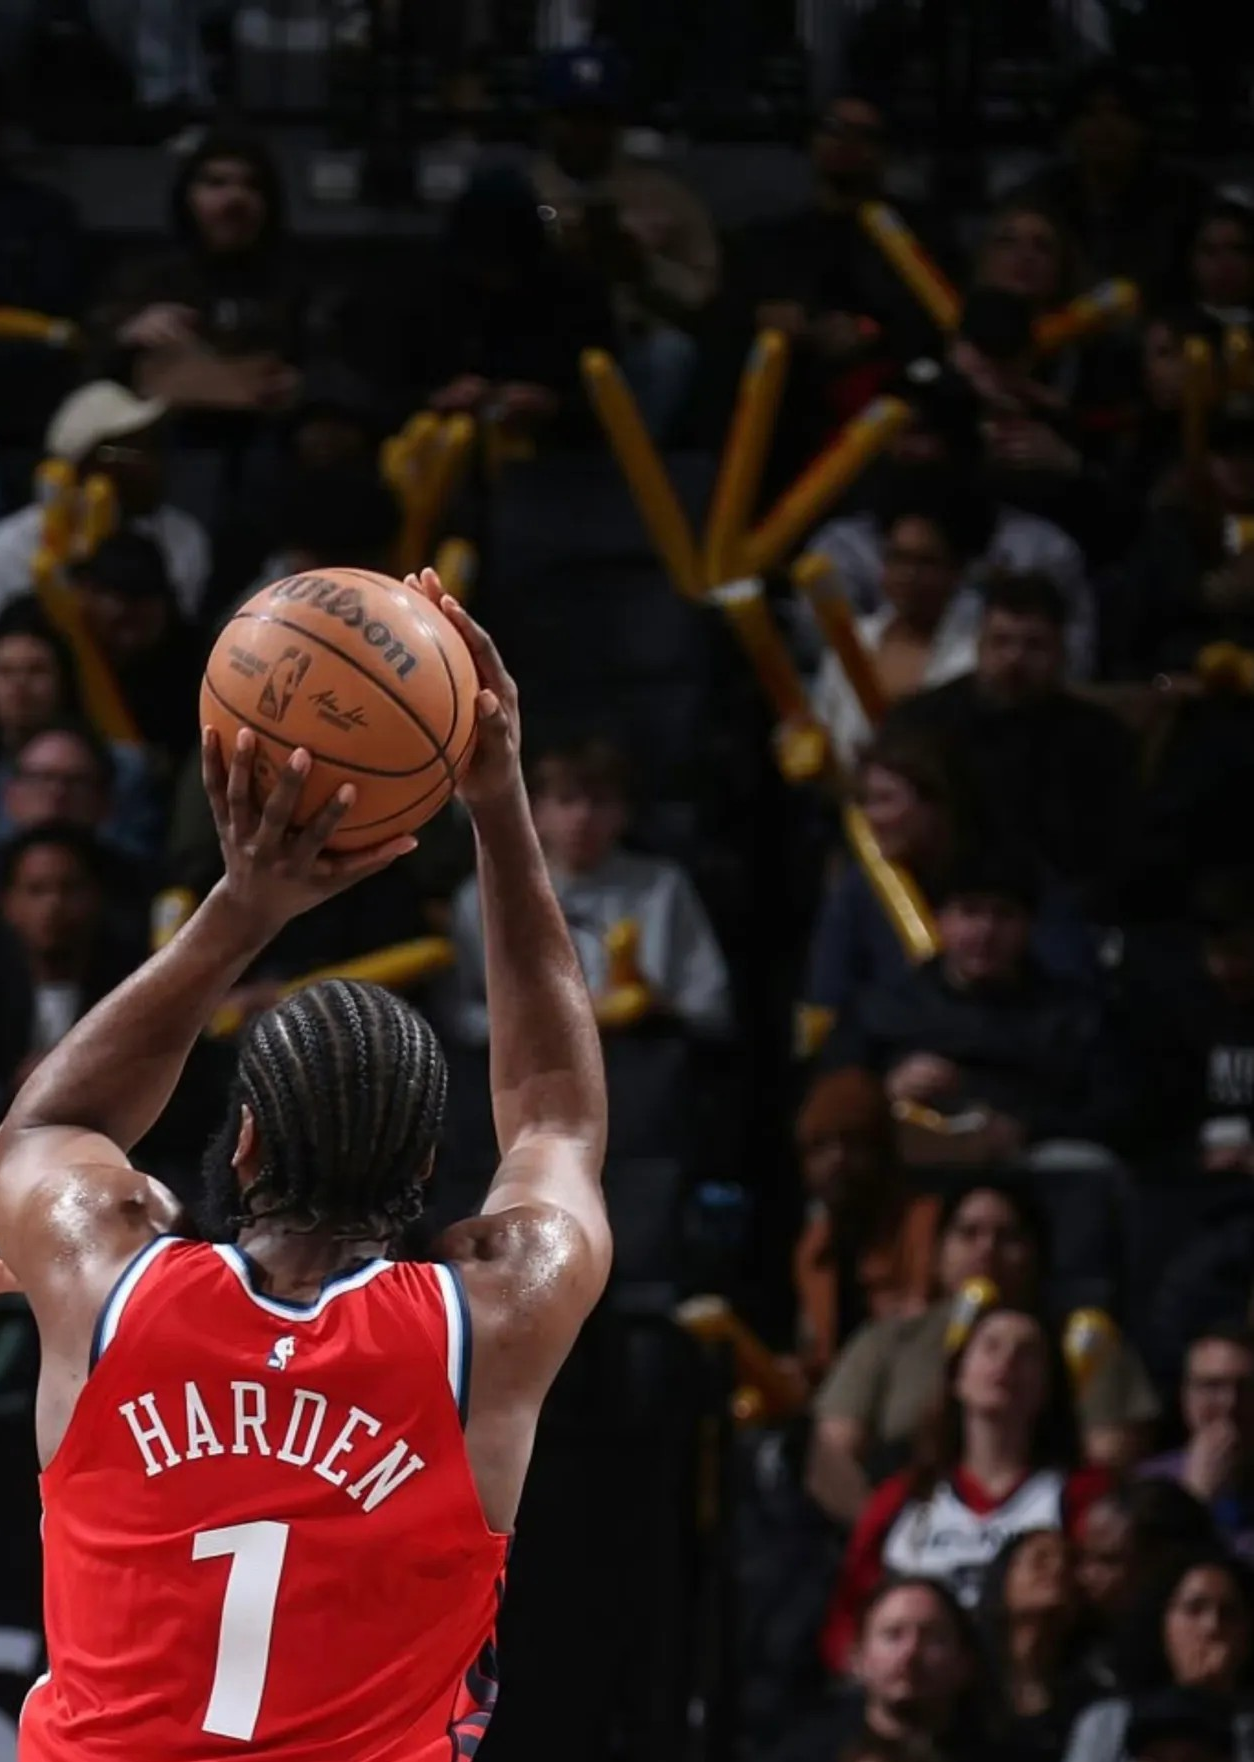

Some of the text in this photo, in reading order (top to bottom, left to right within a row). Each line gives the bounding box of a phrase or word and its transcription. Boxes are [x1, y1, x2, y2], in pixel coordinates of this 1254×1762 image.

[270, 576, 418, 682] Wilson
[119, 1380, 426, 1513] HARDEN
[192, 1519, 290, 1742] 1
